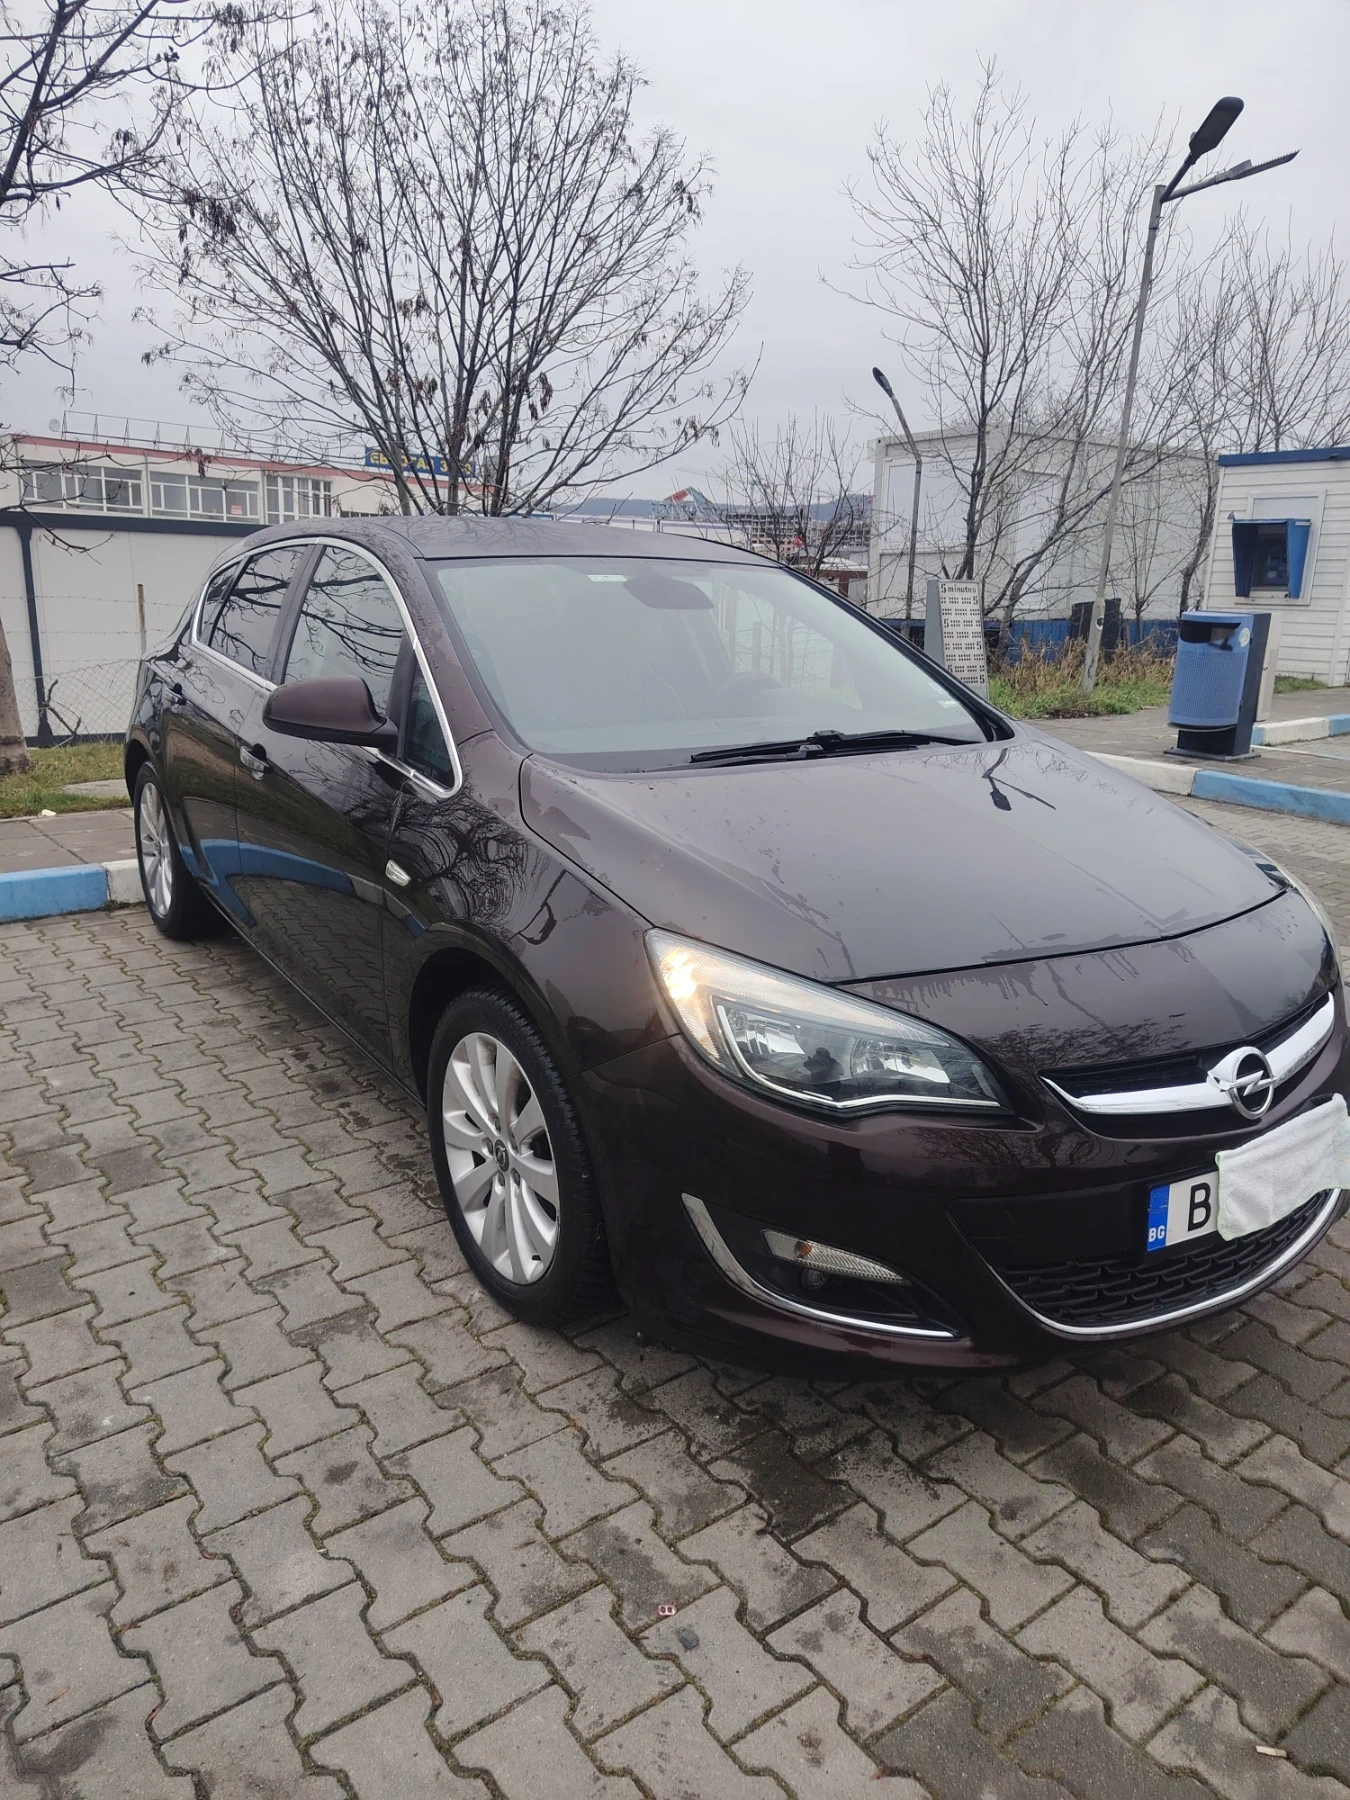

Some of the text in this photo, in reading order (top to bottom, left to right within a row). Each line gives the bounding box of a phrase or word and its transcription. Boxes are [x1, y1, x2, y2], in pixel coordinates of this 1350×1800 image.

[941, 584, 977, 594] 5 minutes
[1187, 1182, 1212, 1232] B
[1148, 1225, 1166, 1242] BG
